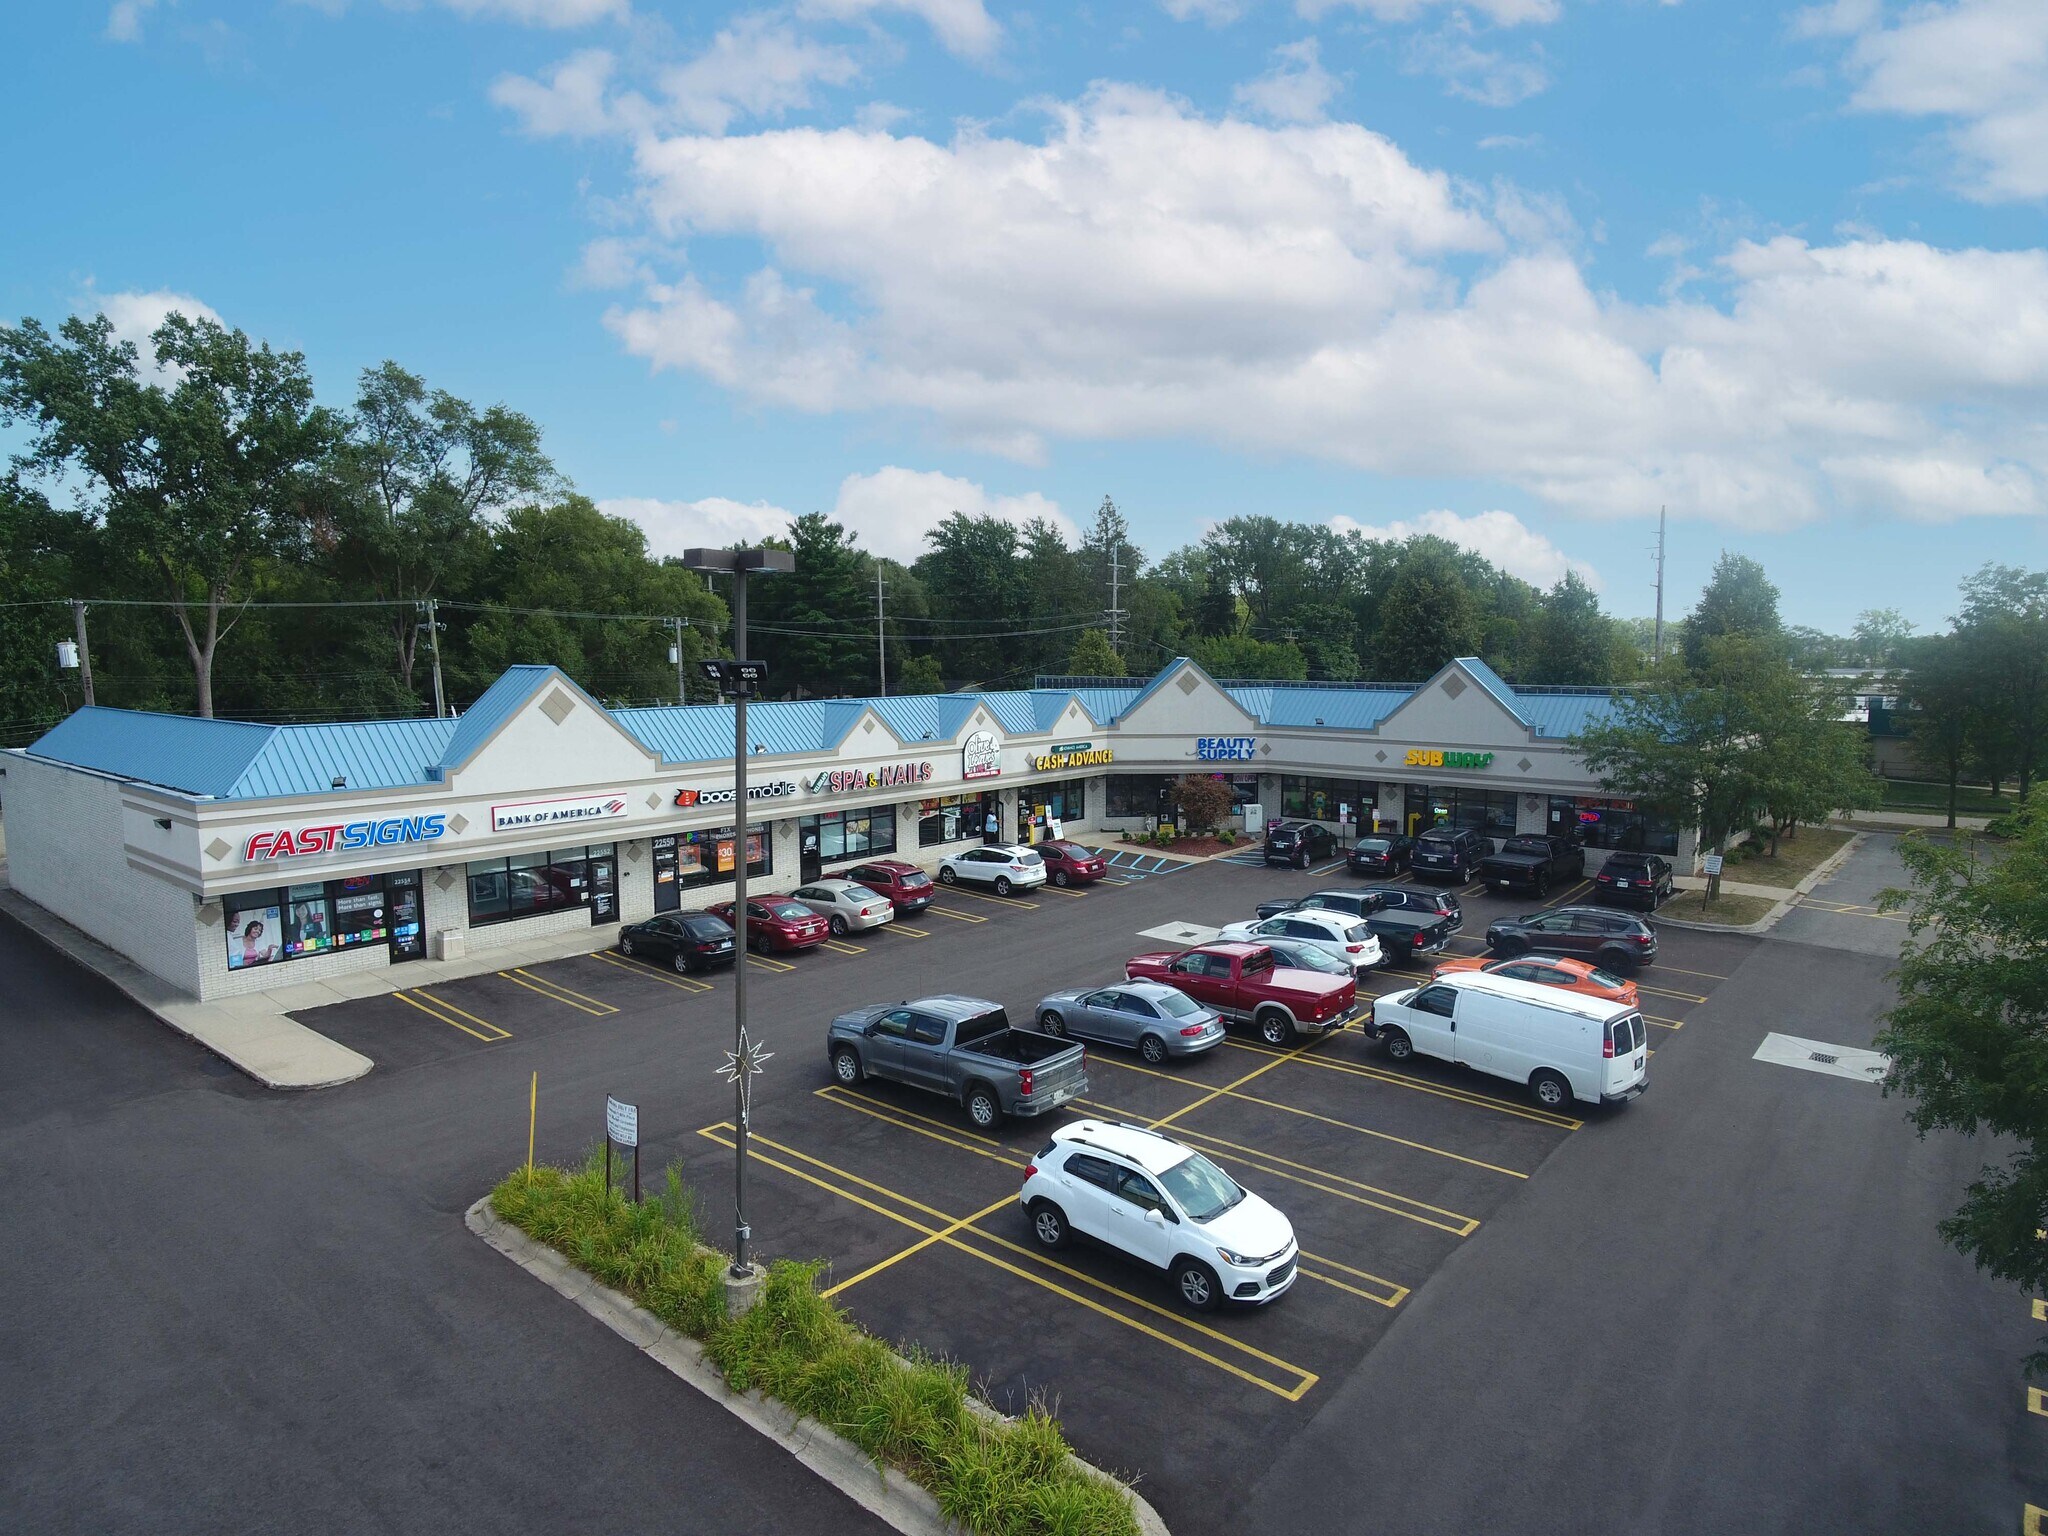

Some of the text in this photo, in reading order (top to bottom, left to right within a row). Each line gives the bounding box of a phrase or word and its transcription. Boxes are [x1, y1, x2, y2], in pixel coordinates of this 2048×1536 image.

[1197, 737, 1256, 749] BEAUTY
[1036, 749, 1113, 771] CASH ADVANCE
[1197, 749, 1255, 760] SUPPLY
[1404, 749, 1494, 769] SUBWAY
[830, 762, 932, 793] SPA & NAILS
[699, 782, 796, 804] boos mobile
[498, 806, 602, 827] BANK OF AMERICA
[1579, 812, 1598, 821] OPEN
[246, 814, 446, 861] FASTSIGNS
[654, 837, 675, 848] 22550
[592, 847, 611, 857] 22552
[719, 847, 733, 858] $30
